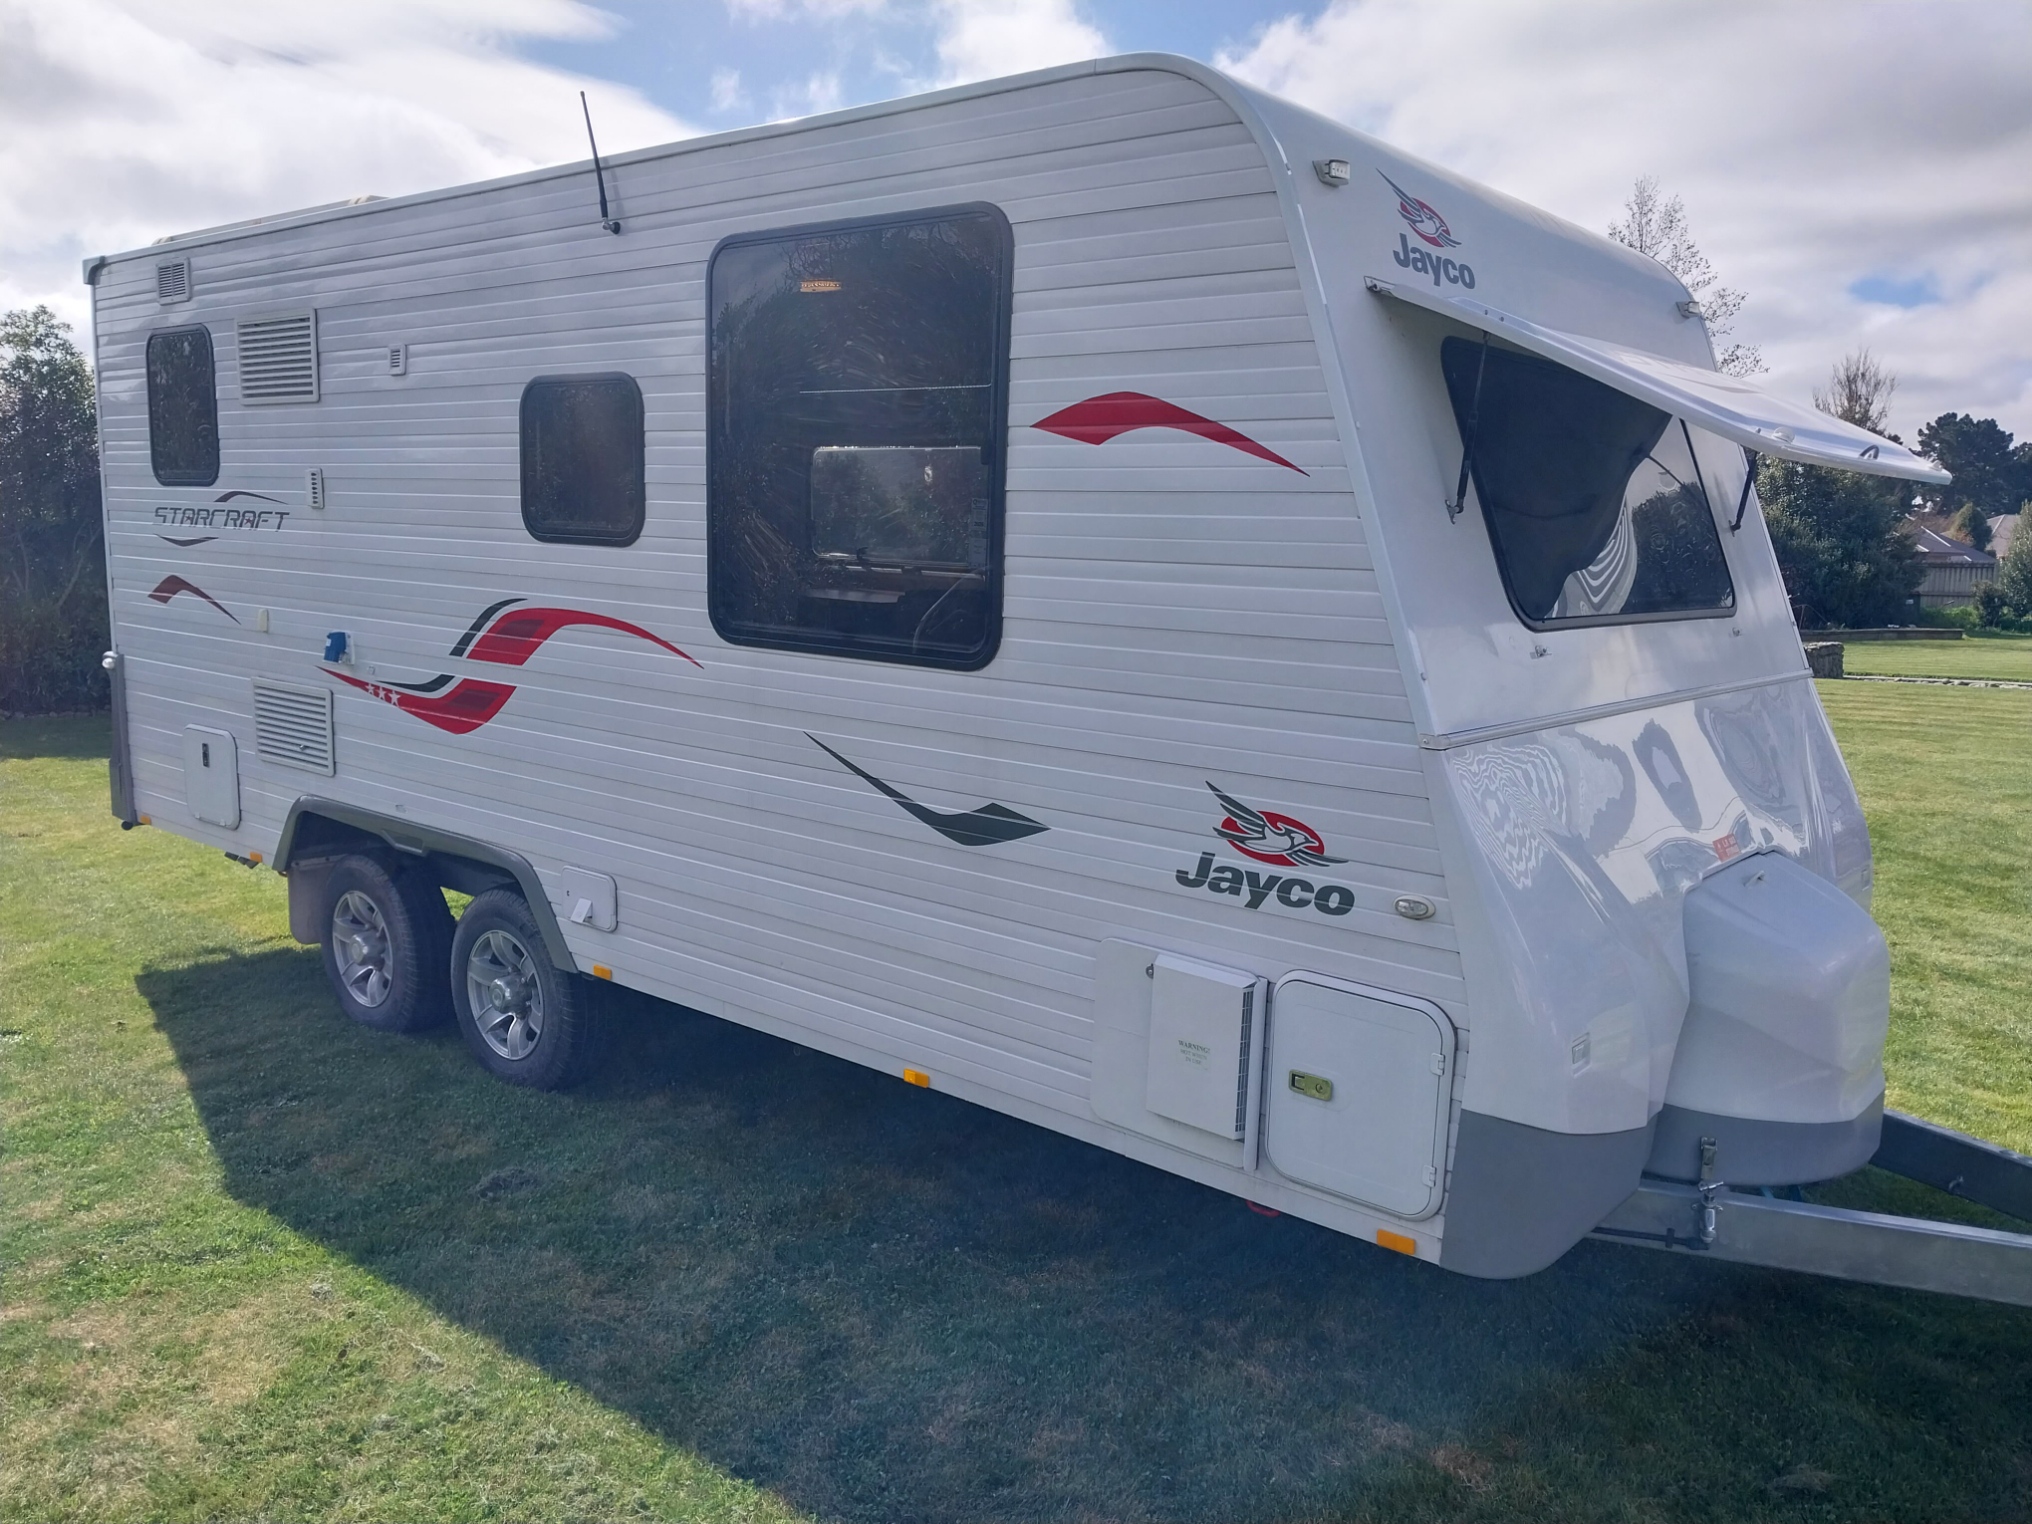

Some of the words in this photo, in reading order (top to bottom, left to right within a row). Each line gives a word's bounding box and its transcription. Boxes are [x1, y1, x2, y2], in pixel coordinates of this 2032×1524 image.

[1393, 232, 1475, 289] Jayco
[154, 506, 290, 532] STARCRAFT
[1175, 851, 1355, 916] Jayco
